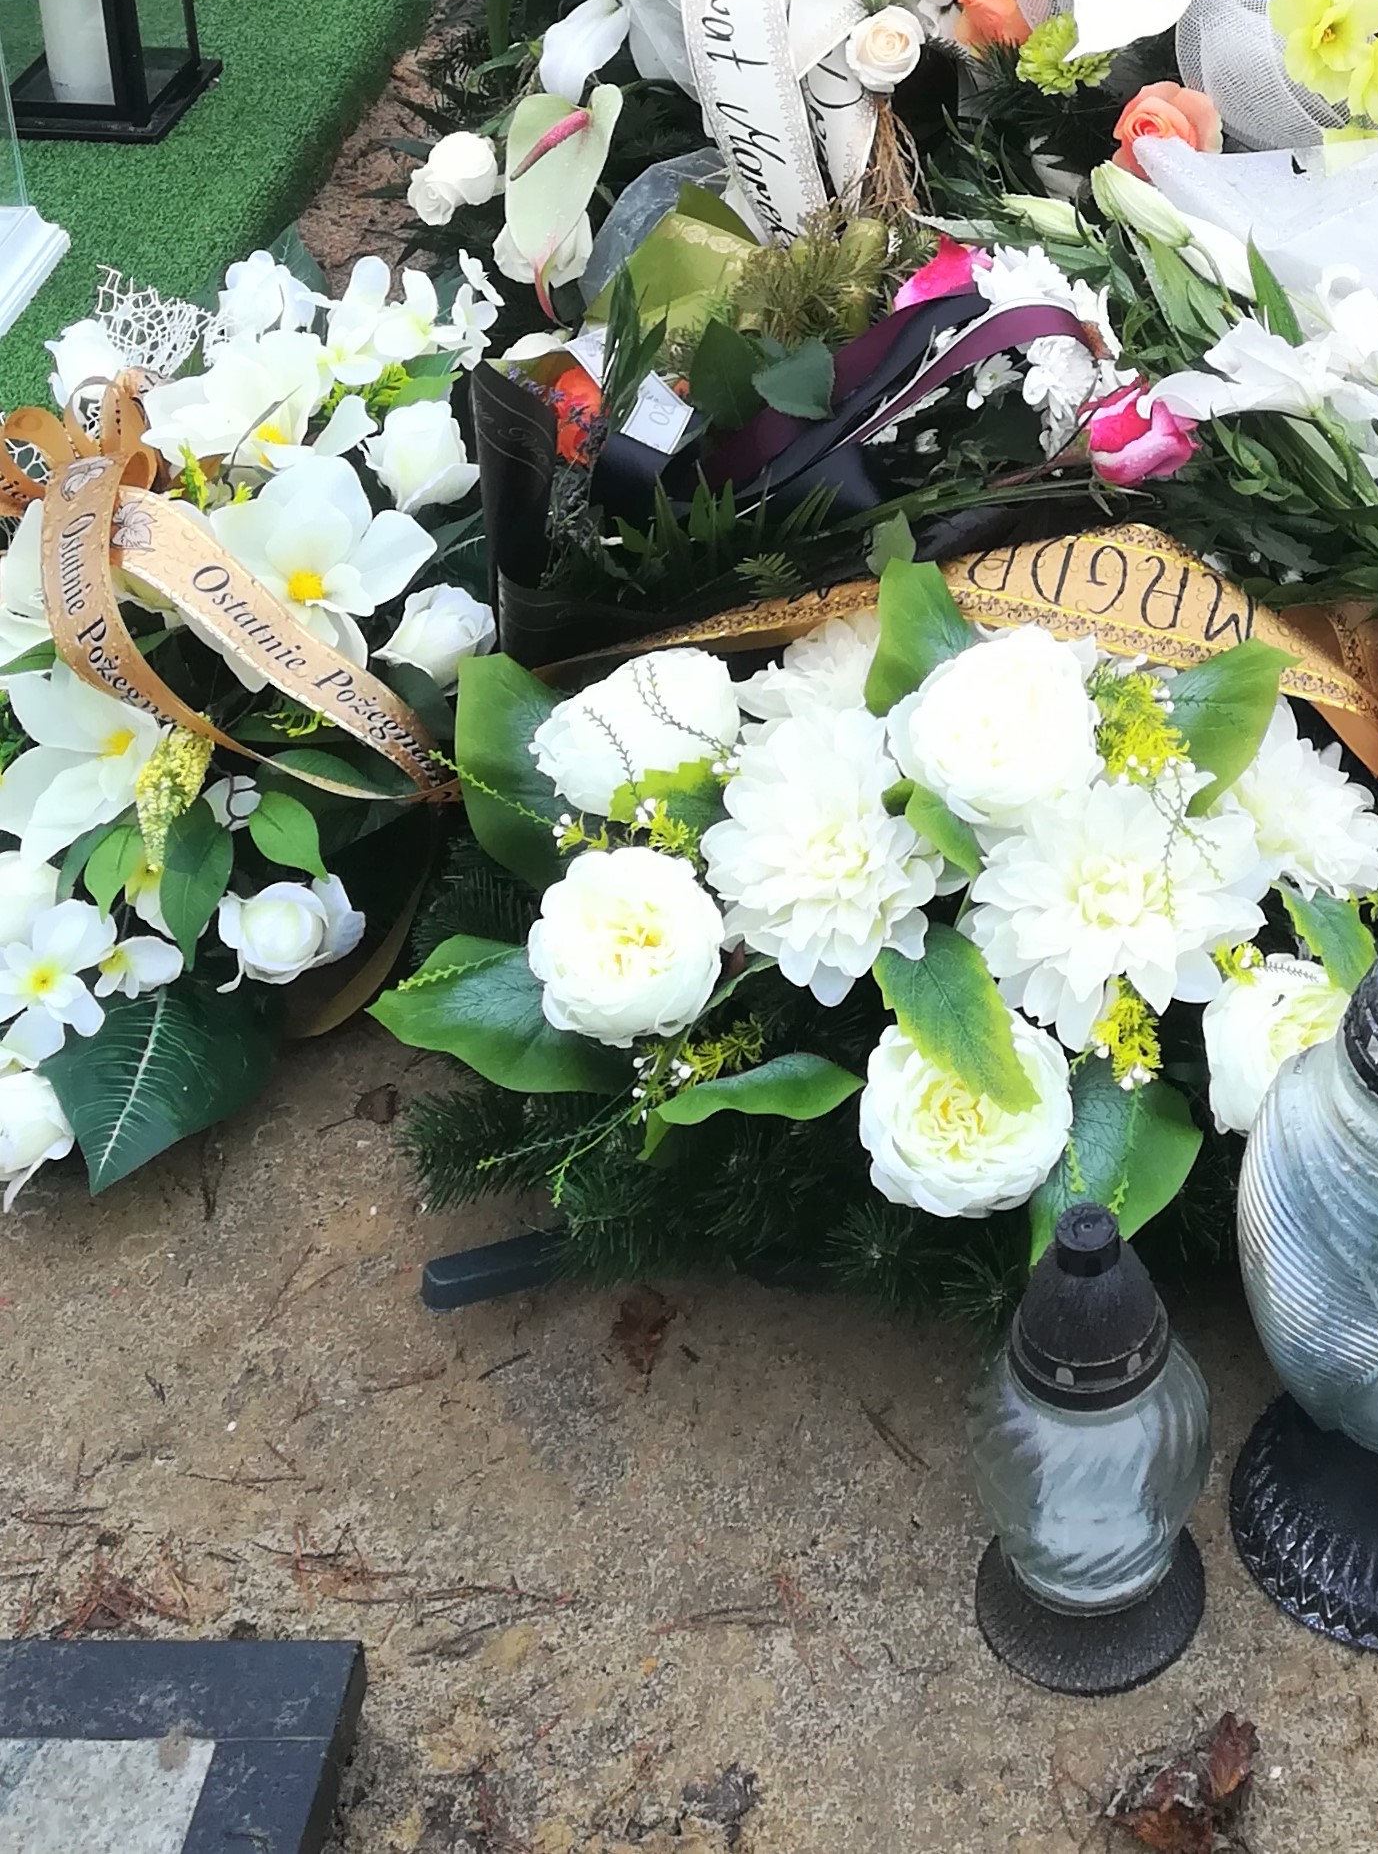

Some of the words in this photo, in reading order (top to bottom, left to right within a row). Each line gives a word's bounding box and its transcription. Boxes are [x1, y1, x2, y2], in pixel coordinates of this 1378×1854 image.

[61, 512, 97, 616] Ostatnie
[192, 564, 307, 670] Ostatnie
[967, 534, 1257, 644] MAGDA
